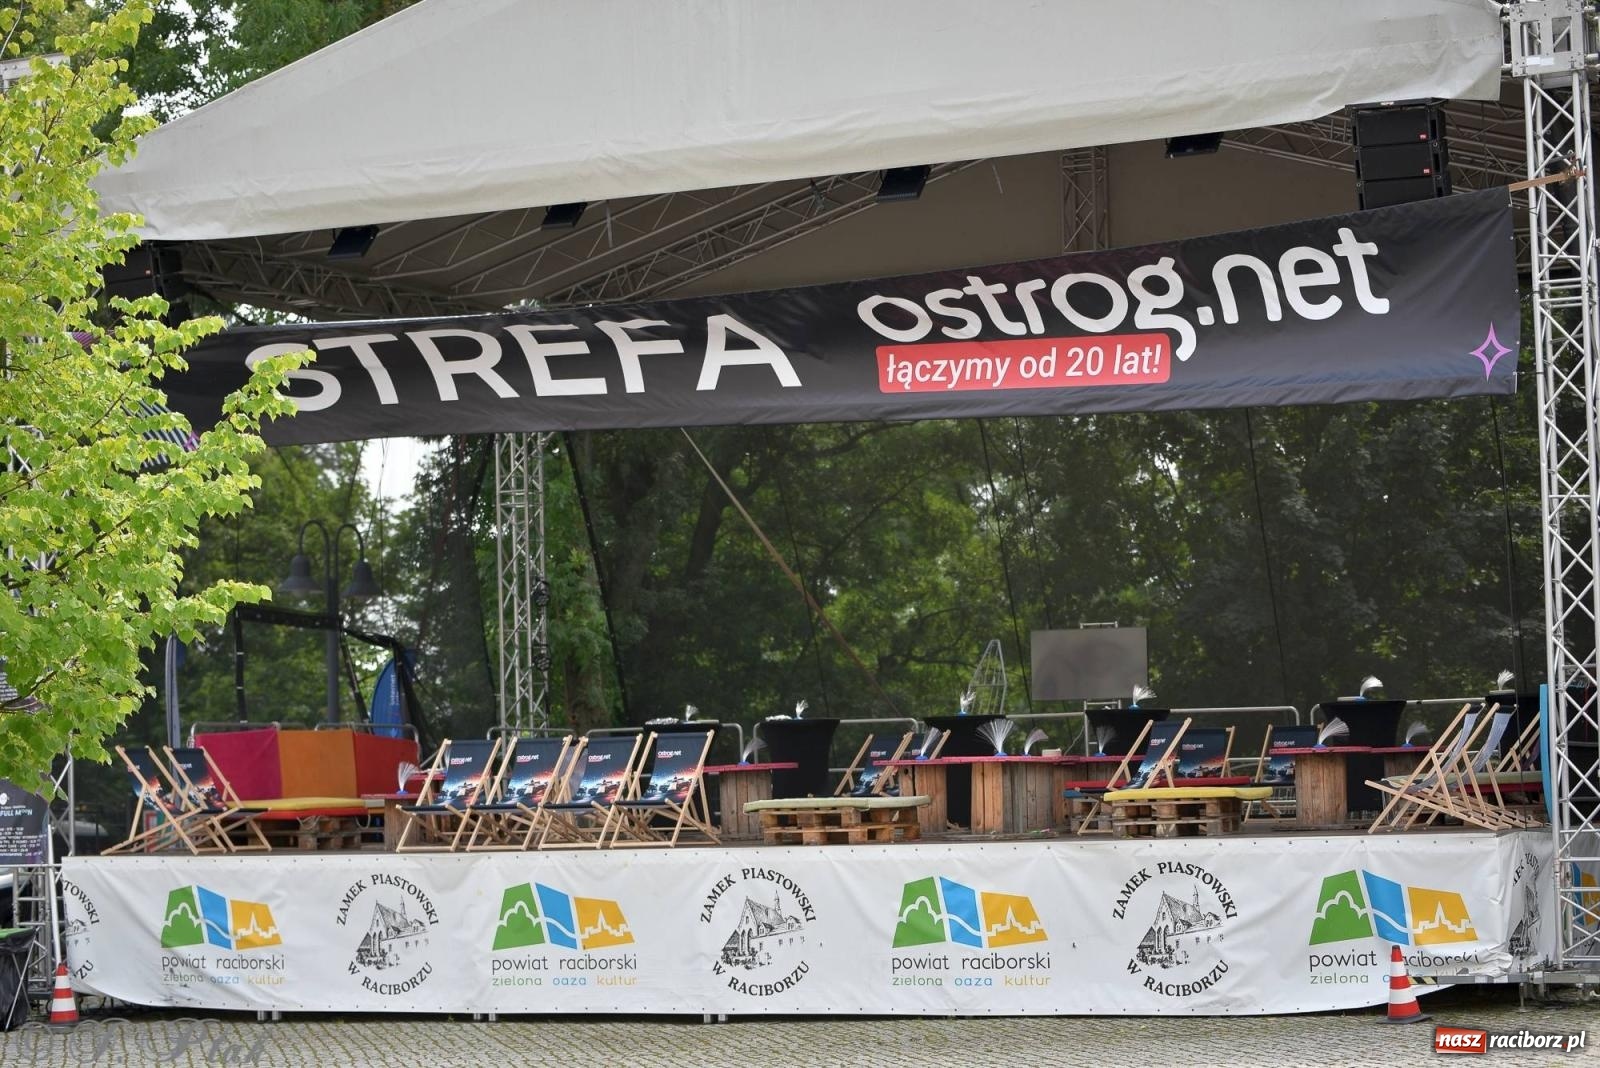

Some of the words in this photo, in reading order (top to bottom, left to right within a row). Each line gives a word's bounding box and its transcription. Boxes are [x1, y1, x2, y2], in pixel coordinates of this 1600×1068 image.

[857, 227, 1390, 361] ostrog.net
[245, 314, 801, 411] STREFA
[886, 354, 1011, 389] łączymy
[1019, 347, 1056, 378] od
[1066, 346, 1104, 377] 20
[1113, 344, 1162, 374] lat!
[337, 880, 367, 926] ZAMEK
[371, 874, 439, 925] PIASTOWSKI
[700, 874, 736, 923] ZAMEK
[741, 868, 816, 922] PIASTOWSKI
[1112, 868, 1152, 919] ZAMEK
[1157, 861, 1238, 919] PIASTOWSKI
[162, 954, 206, 970] powiat
[216, 954, 285, 970] raciborski
[492, 954, 548, 975] powiat
[559, 953, 637, 970] raciborski
[892, 953, 949, 974] powiat
[962, 952, 1050, 970] raciborski
[1127, 958, 1141, 974] W
[1143, 960, 1229, 996] RACIBORZU
[1309, 949, 1377, 972] powiat
[348, 961, 360, 975] W
[362, 962, 433, 995] RACIBORZU
[492, 975, 542, 986] zielona
[552, 976, 587, 986] oaza
[597, 975, 637, 986] kultur
[712, 961, 726, 975] W
[728, 961, 810, 996] RACIBORZU
[892, 974, 943, 986] zielona
[954, 976, 993, 986] oaza
[1004, 974, 1050, 986] kultur
[1310, 972, 1369, 985] zielona
